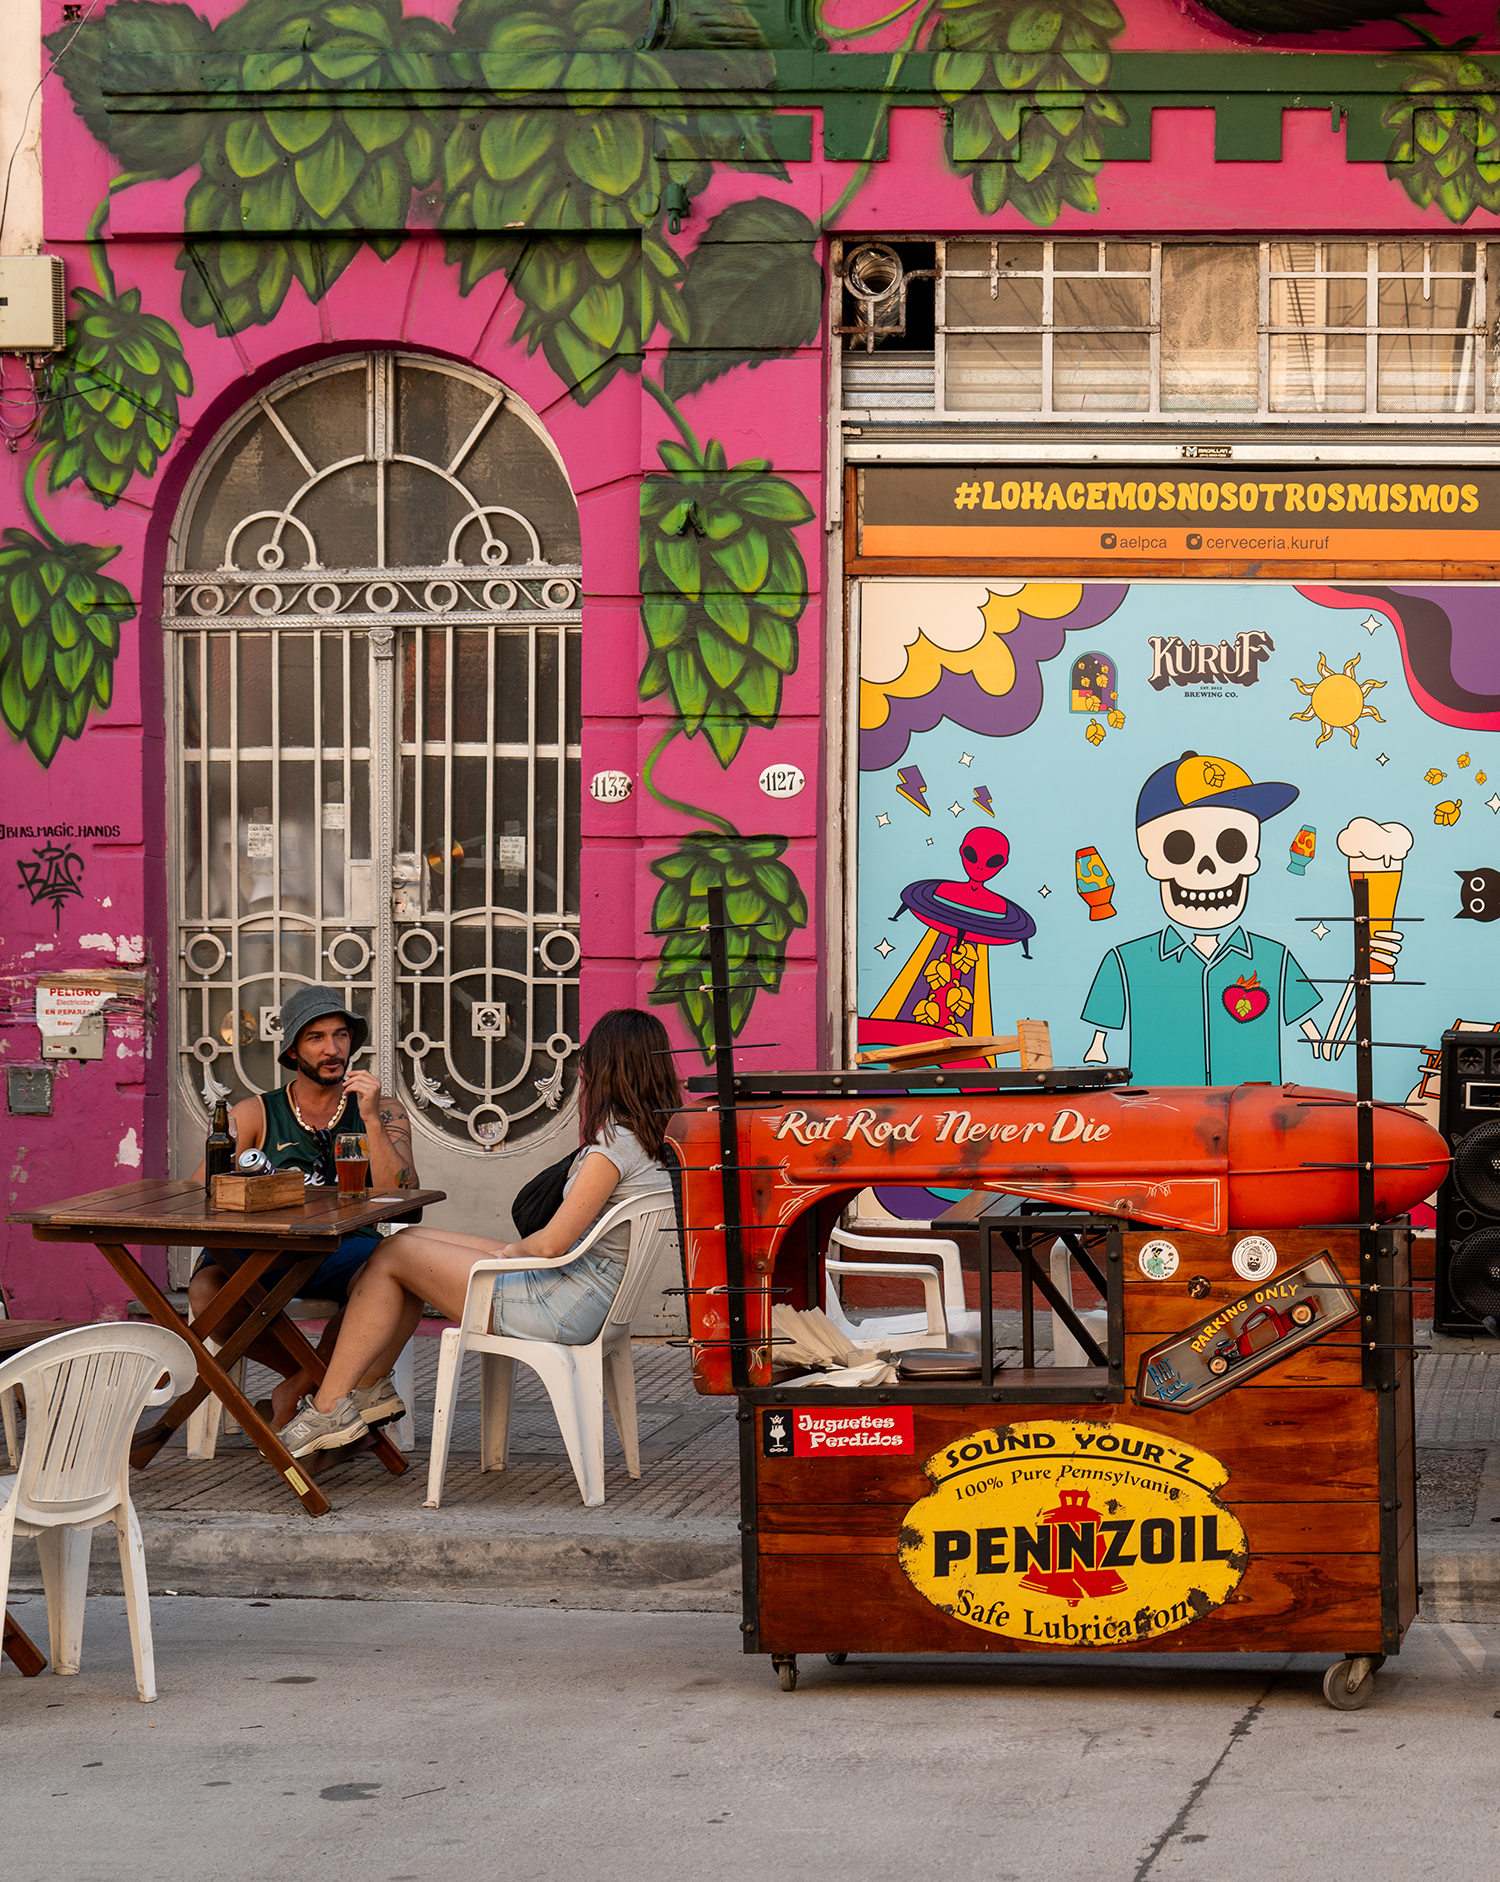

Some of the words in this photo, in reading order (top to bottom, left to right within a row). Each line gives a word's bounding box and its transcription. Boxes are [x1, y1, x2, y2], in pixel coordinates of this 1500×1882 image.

[954, 480, 1480, 514] #LOHACEMOSNOSOTROSMISMOS
[1119, 534, 1168, 551] aelpca
[1206, 534, 1330, 551] cerveceria.kuruf
[593, 776, 628, 797] 1133
[765, 771, 796, 791] 1127
[49, 988, 101, 997] PELIGRO
[774, 1109, 843, 1146] Rat
[842, 1108, 923, 1147] Rod
[934, 1109, 1046, 1145] Never
[1048, 1108, 1113, 1145] Die
[1190, 1299, 1249, 1355] PARKING
[1254, 1283, 1300, 1305] ONLY
[1147, 1357, 1177, 1386] RAT
[1152, 1371, 1190, 1401] Rod
[798, 1414, 896, 1433] Juguetes
[809, 1431, 904, 1449] Perdidos
[945, 1432, 1056, 1469] SOUND
[956, 1476, 1004, 1500] 100%
[1010, 1467, 1052, 1486] Pure
[1059, 1464, 1182, 1499] Pennsylvania
[932, 1514, 1235, 1578] PENNZOIL
[956, 1588, 1011, 1627] Safe
